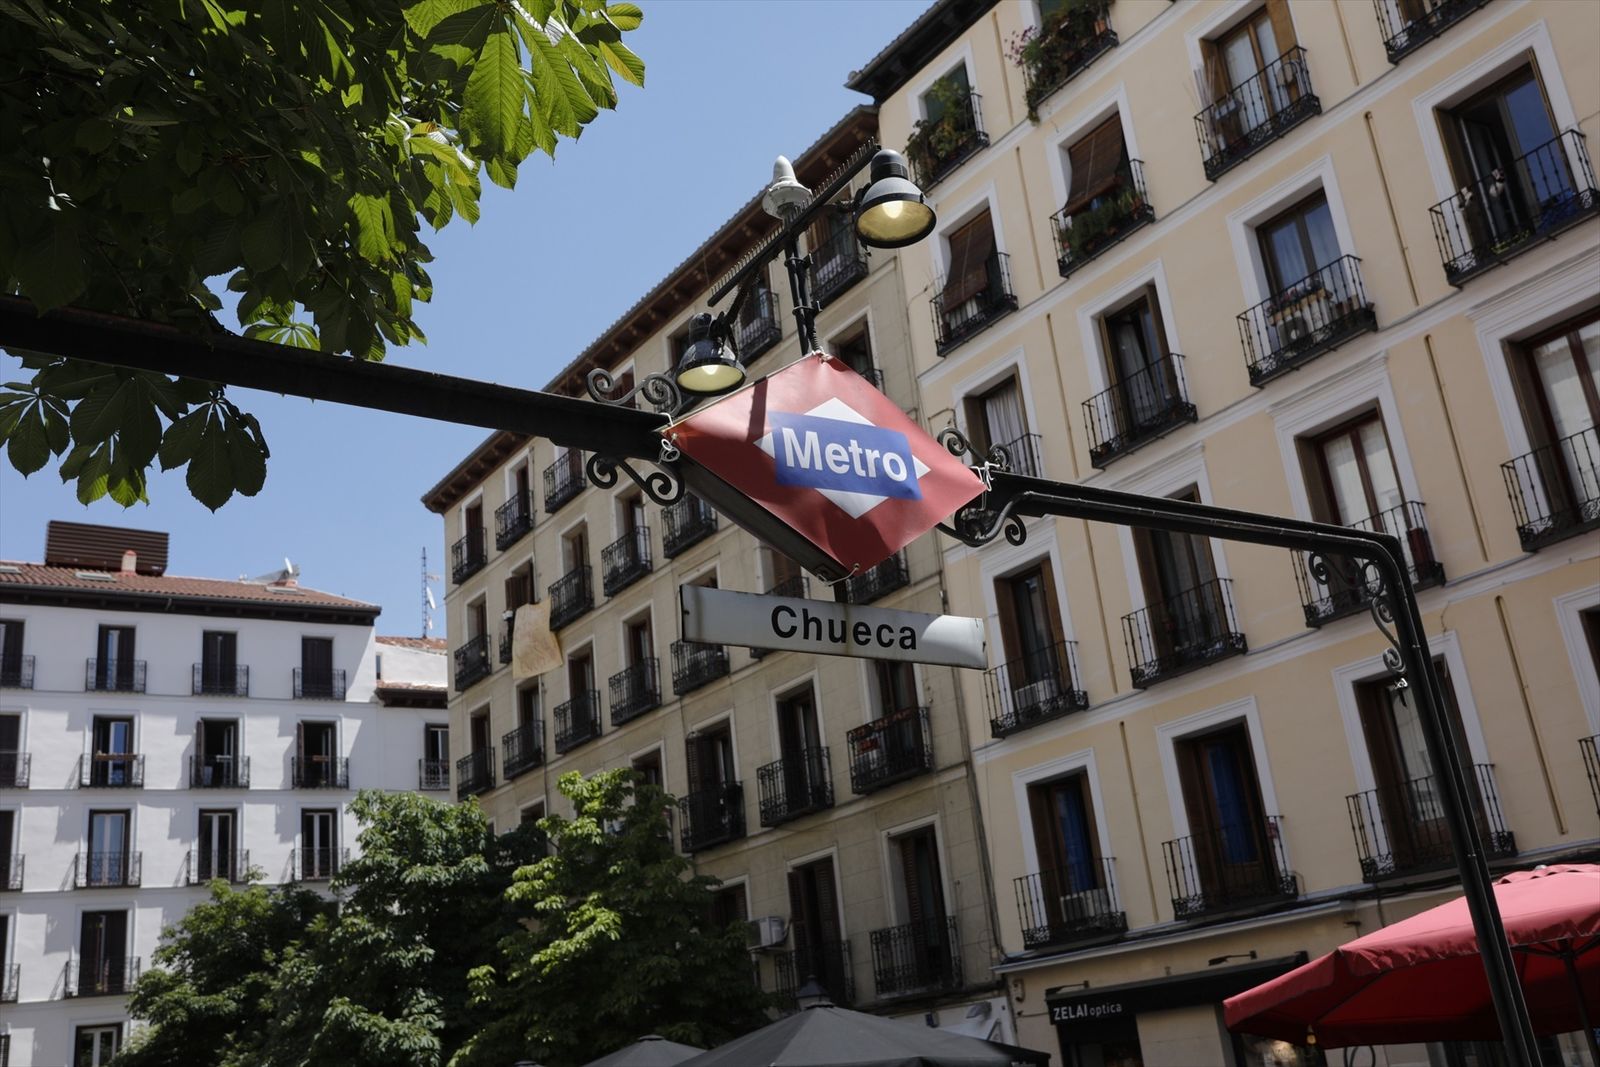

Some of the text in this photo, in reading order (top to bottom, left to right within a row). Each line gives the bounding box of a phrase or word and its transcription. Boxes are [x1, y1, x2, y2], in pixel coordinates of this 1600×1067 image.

[781, 427, 908, 482] Metro
[771, 606, 917, 650] Chueca
[1053, 1003, 1122, 1020] ZELAI optica
